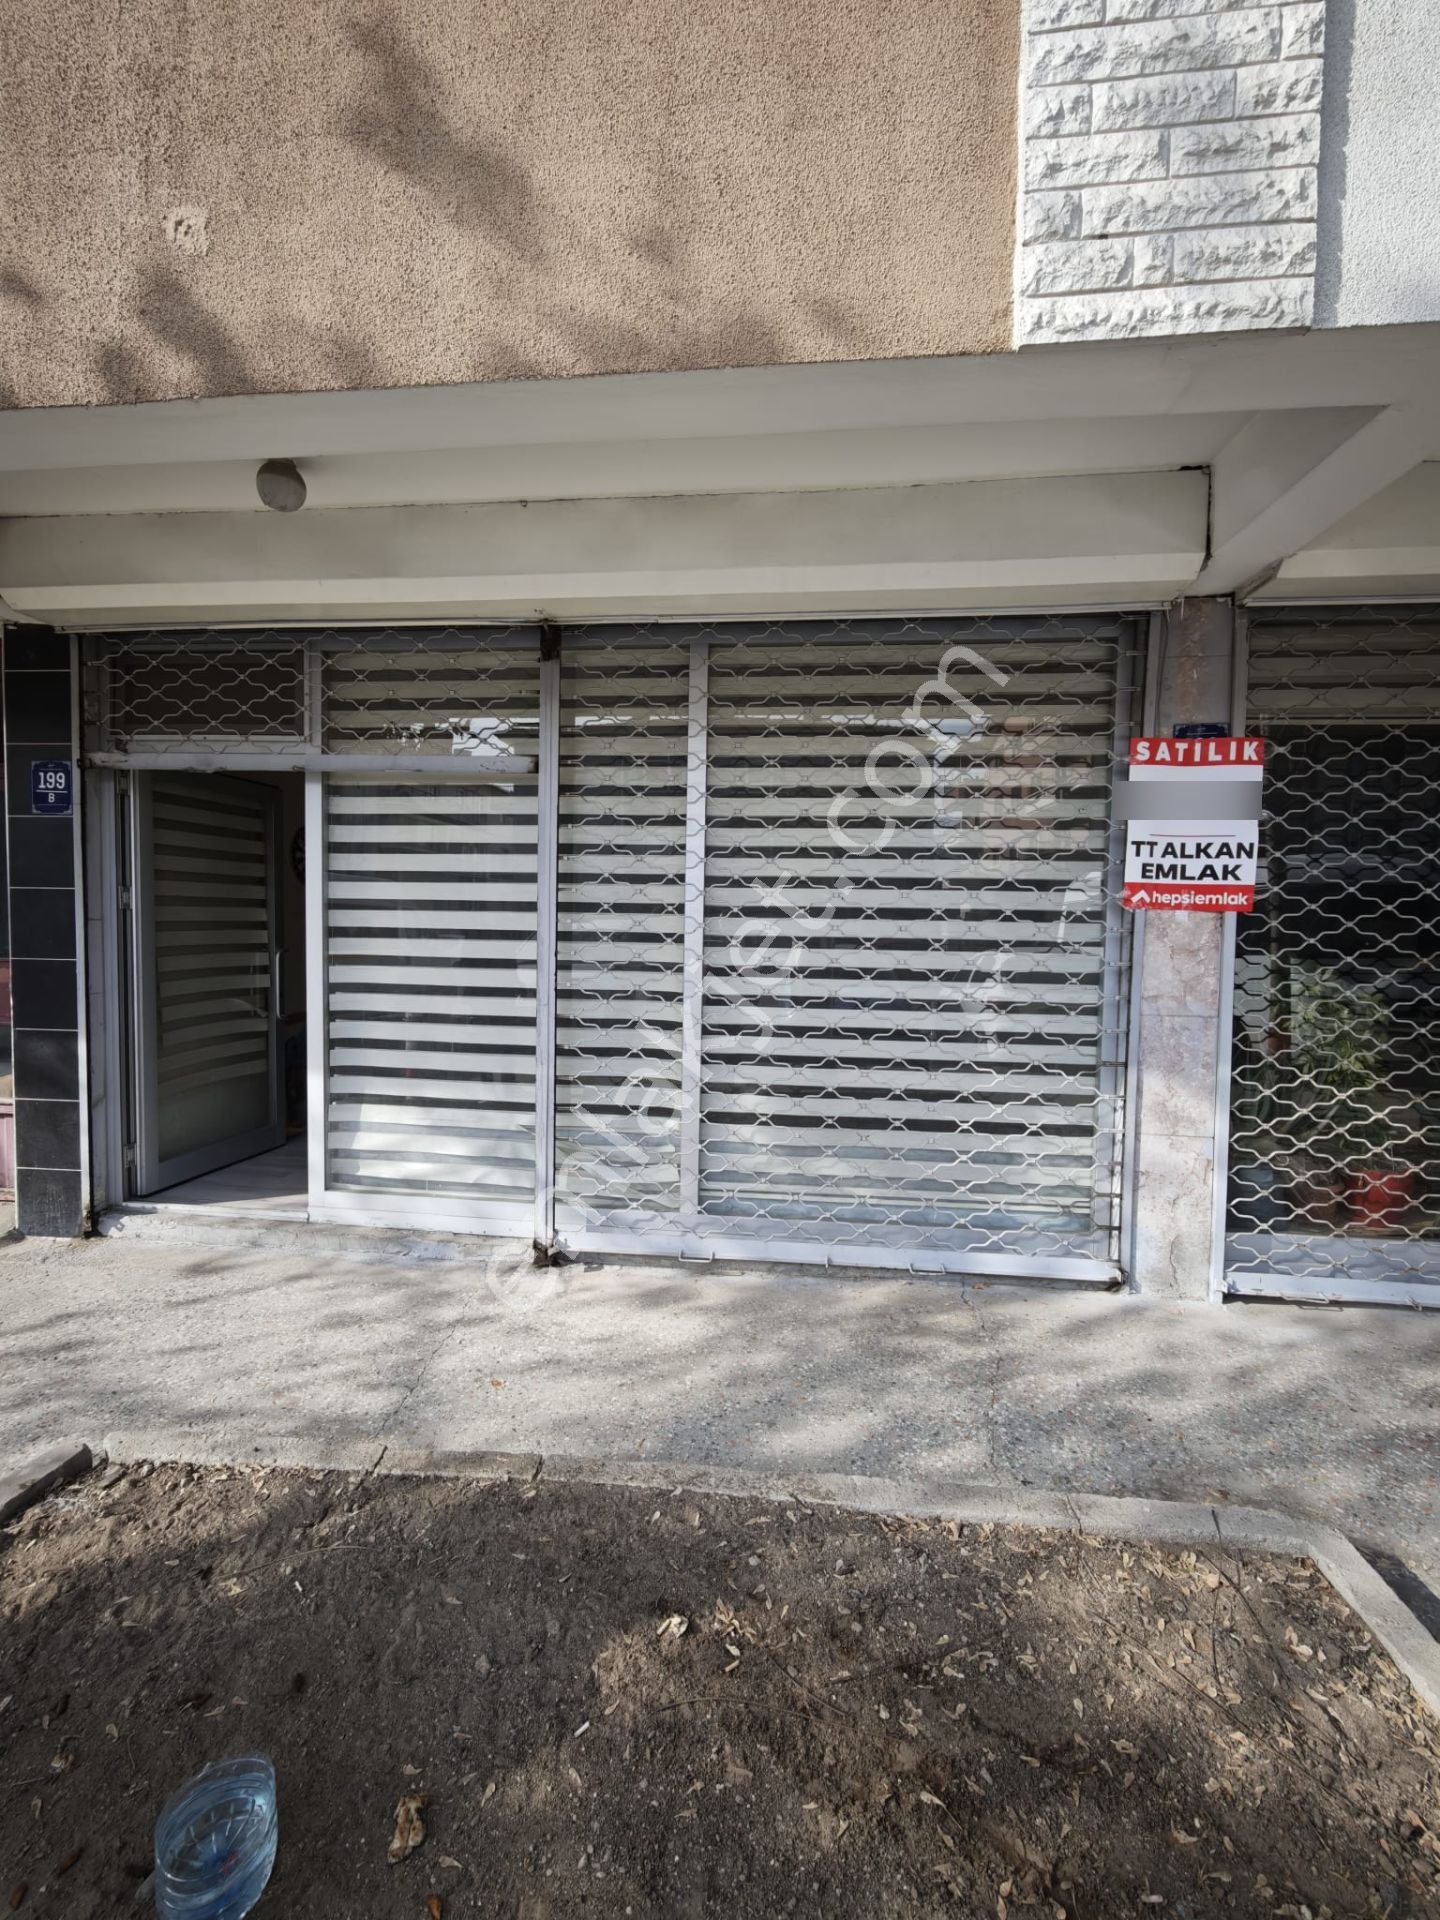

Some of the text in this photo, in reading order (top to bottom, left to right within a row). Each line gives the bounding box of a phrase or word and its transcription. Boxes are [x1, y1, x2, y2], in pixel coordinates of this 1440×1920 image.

[1136, 741, 1259, 762] SATILIK
[38, 771, 66, 789] 199
[48, 792, 55, 803] B
[1141, 863, 1242, 881] EMLAK
[1152, 890, 1248, 906] hepsiemlak
